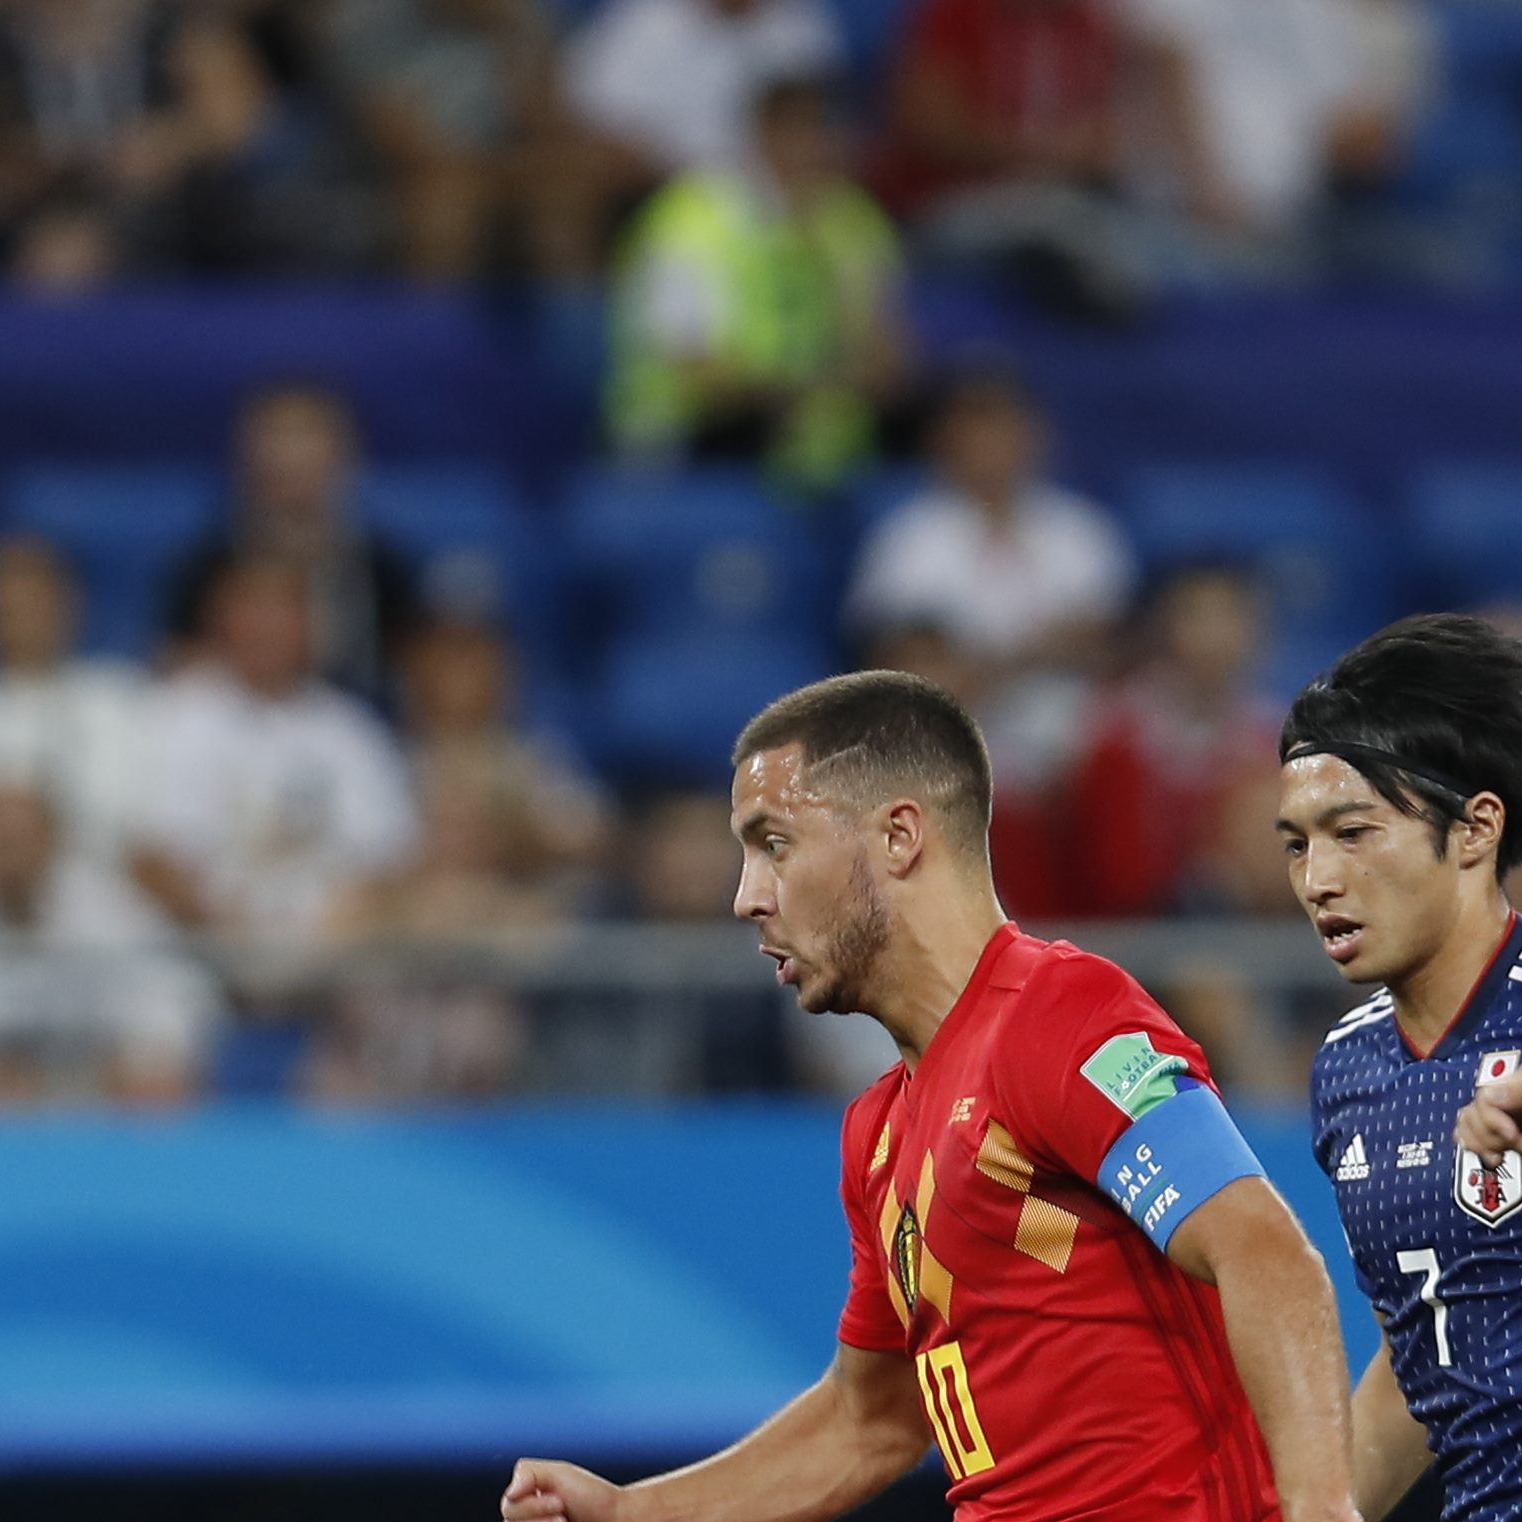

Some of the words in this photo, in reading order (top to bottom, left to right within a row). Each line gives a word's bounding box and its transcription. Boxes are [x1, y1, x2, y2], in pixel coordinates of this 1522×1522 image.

[1144, 1185, 1181, 1231] FIFA
[1396, 1247, 1451, 1367] 7
[916, 1341, 996, 1481] 10
